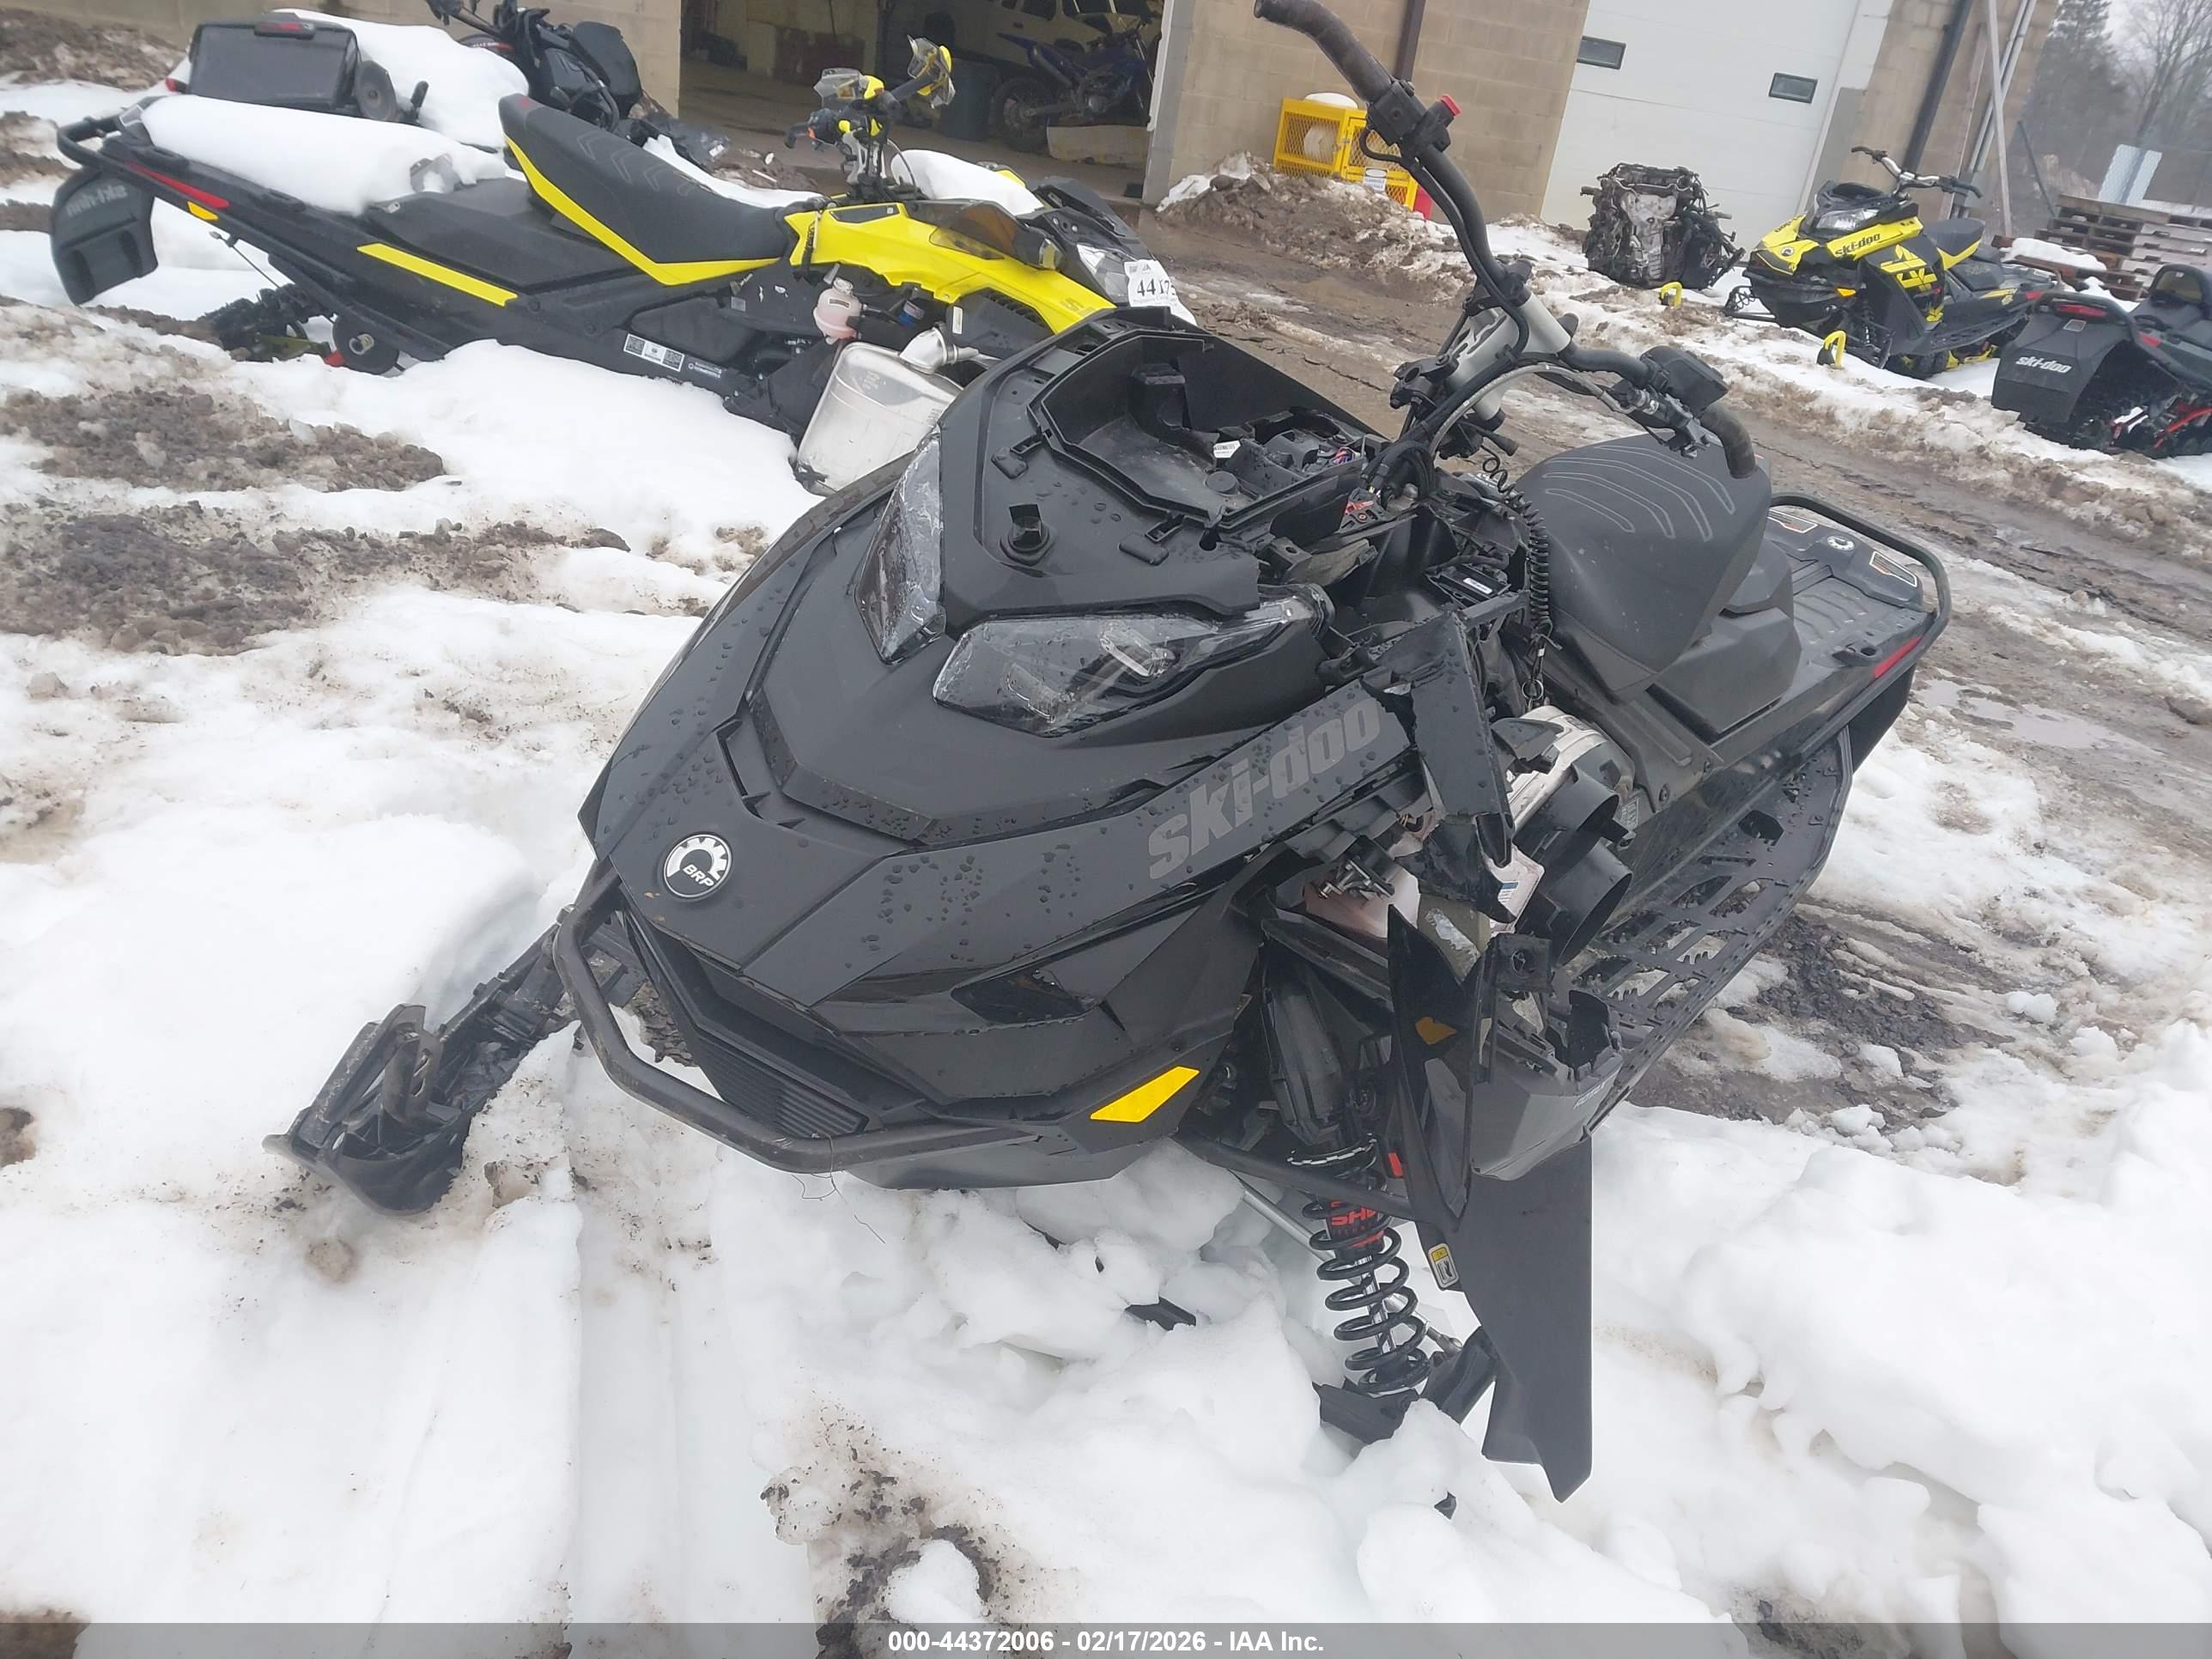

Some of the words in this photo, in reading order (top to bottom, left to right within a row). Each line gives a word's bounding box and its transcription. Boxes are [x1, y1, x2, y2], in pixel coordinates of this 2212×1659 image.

[1834, 233, 1881, 257] ski-doo
[2014, 356, 2073, 374] ski-doo
[1147, 697, 1381, 880] ski-doo
[683, 864, 714, 886] BRP
